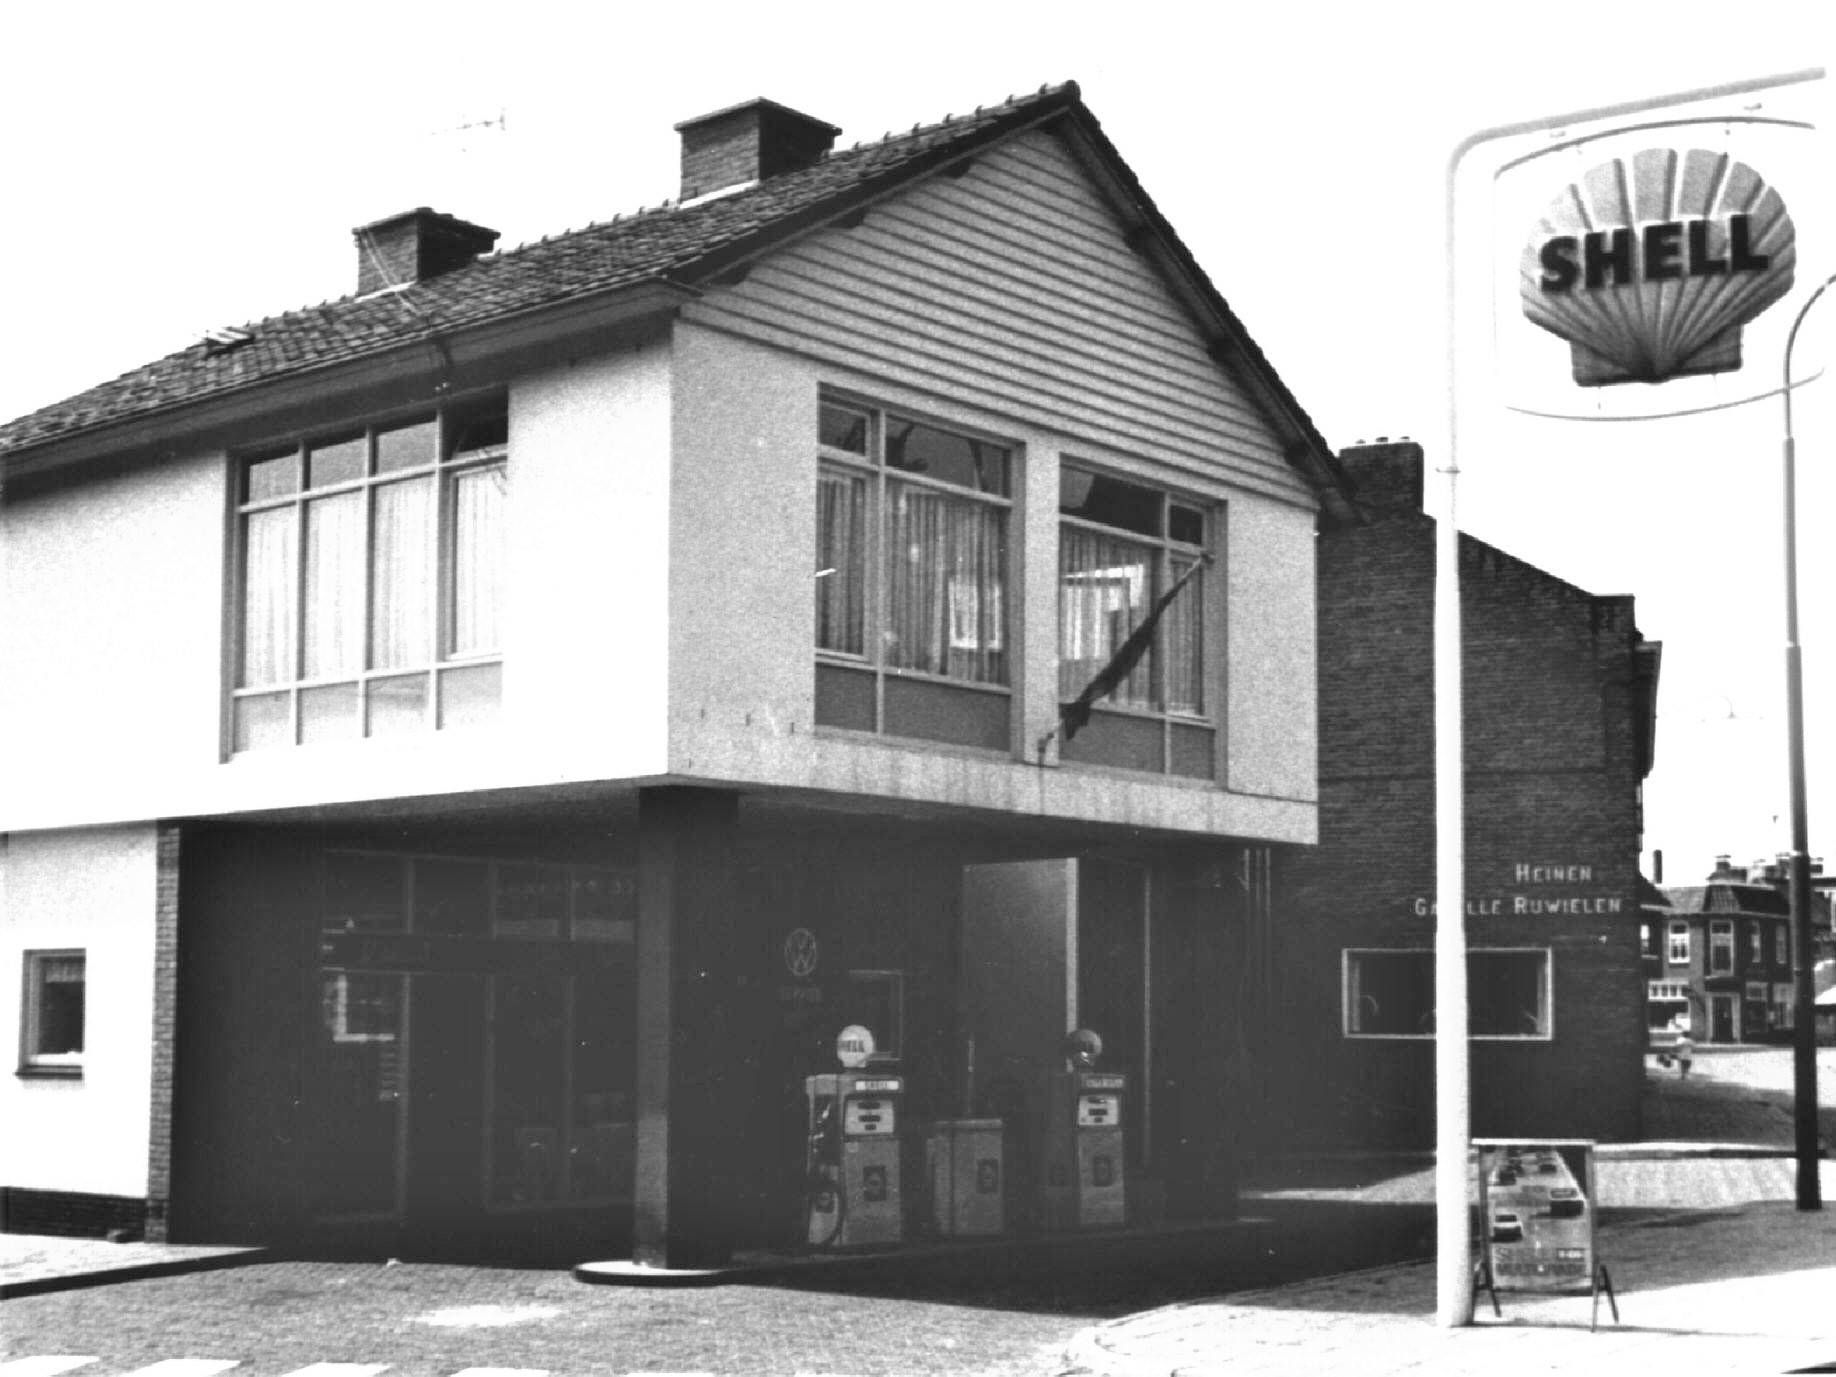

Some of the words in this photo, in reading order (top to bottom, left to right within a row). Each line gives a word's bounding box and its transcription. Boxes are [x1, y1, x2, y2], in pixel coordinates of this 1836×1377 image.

[1538, 214, 1770, 296] SHELL
[1515, 863, 1592, 883] HEINEN
[1414, 897, 1502, 916] GALLE
[1513, 896, 1621, 915] RUWIELEN
